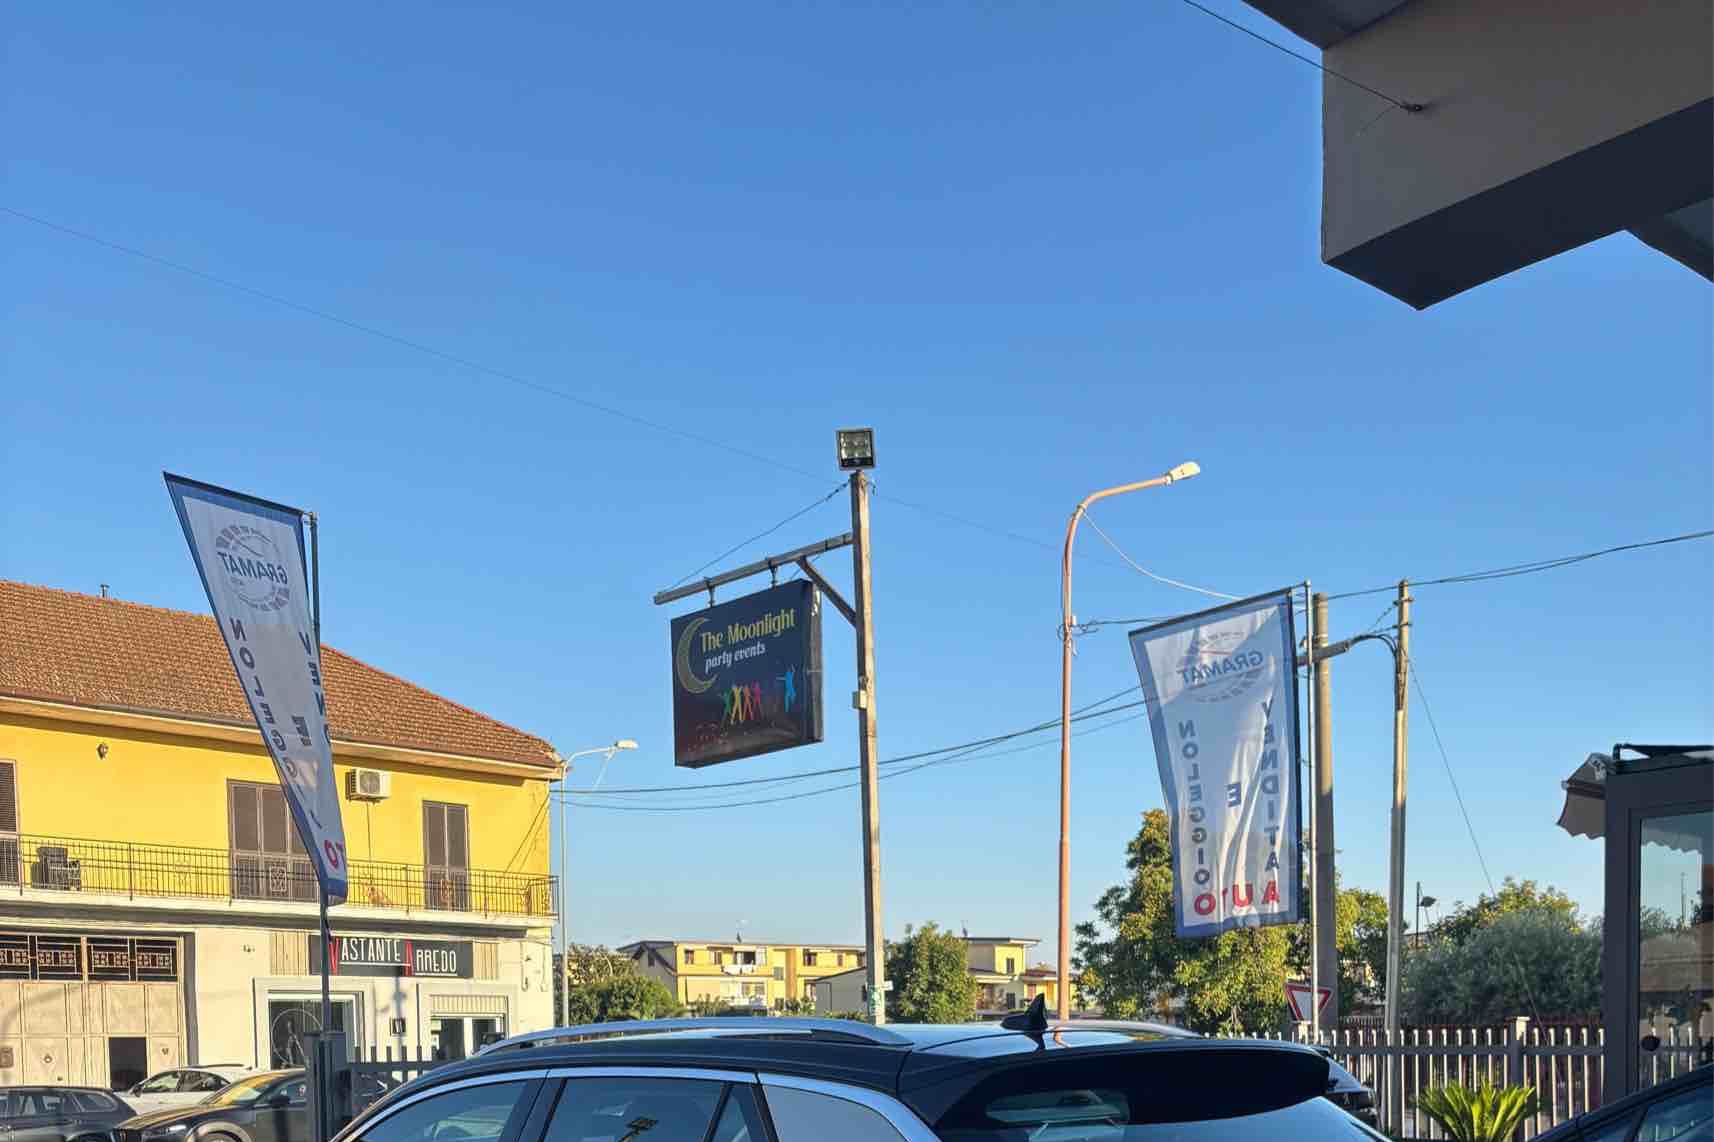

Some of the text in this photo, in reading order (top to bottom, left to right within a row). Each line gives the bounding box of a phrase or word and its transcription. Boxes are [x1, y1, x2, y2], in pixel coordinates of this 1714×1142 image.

[702, 608, 796, 652] The Moonlight
[705, 641, 766, 674] party events
[328, 937, 400, 976] VASTANTE
